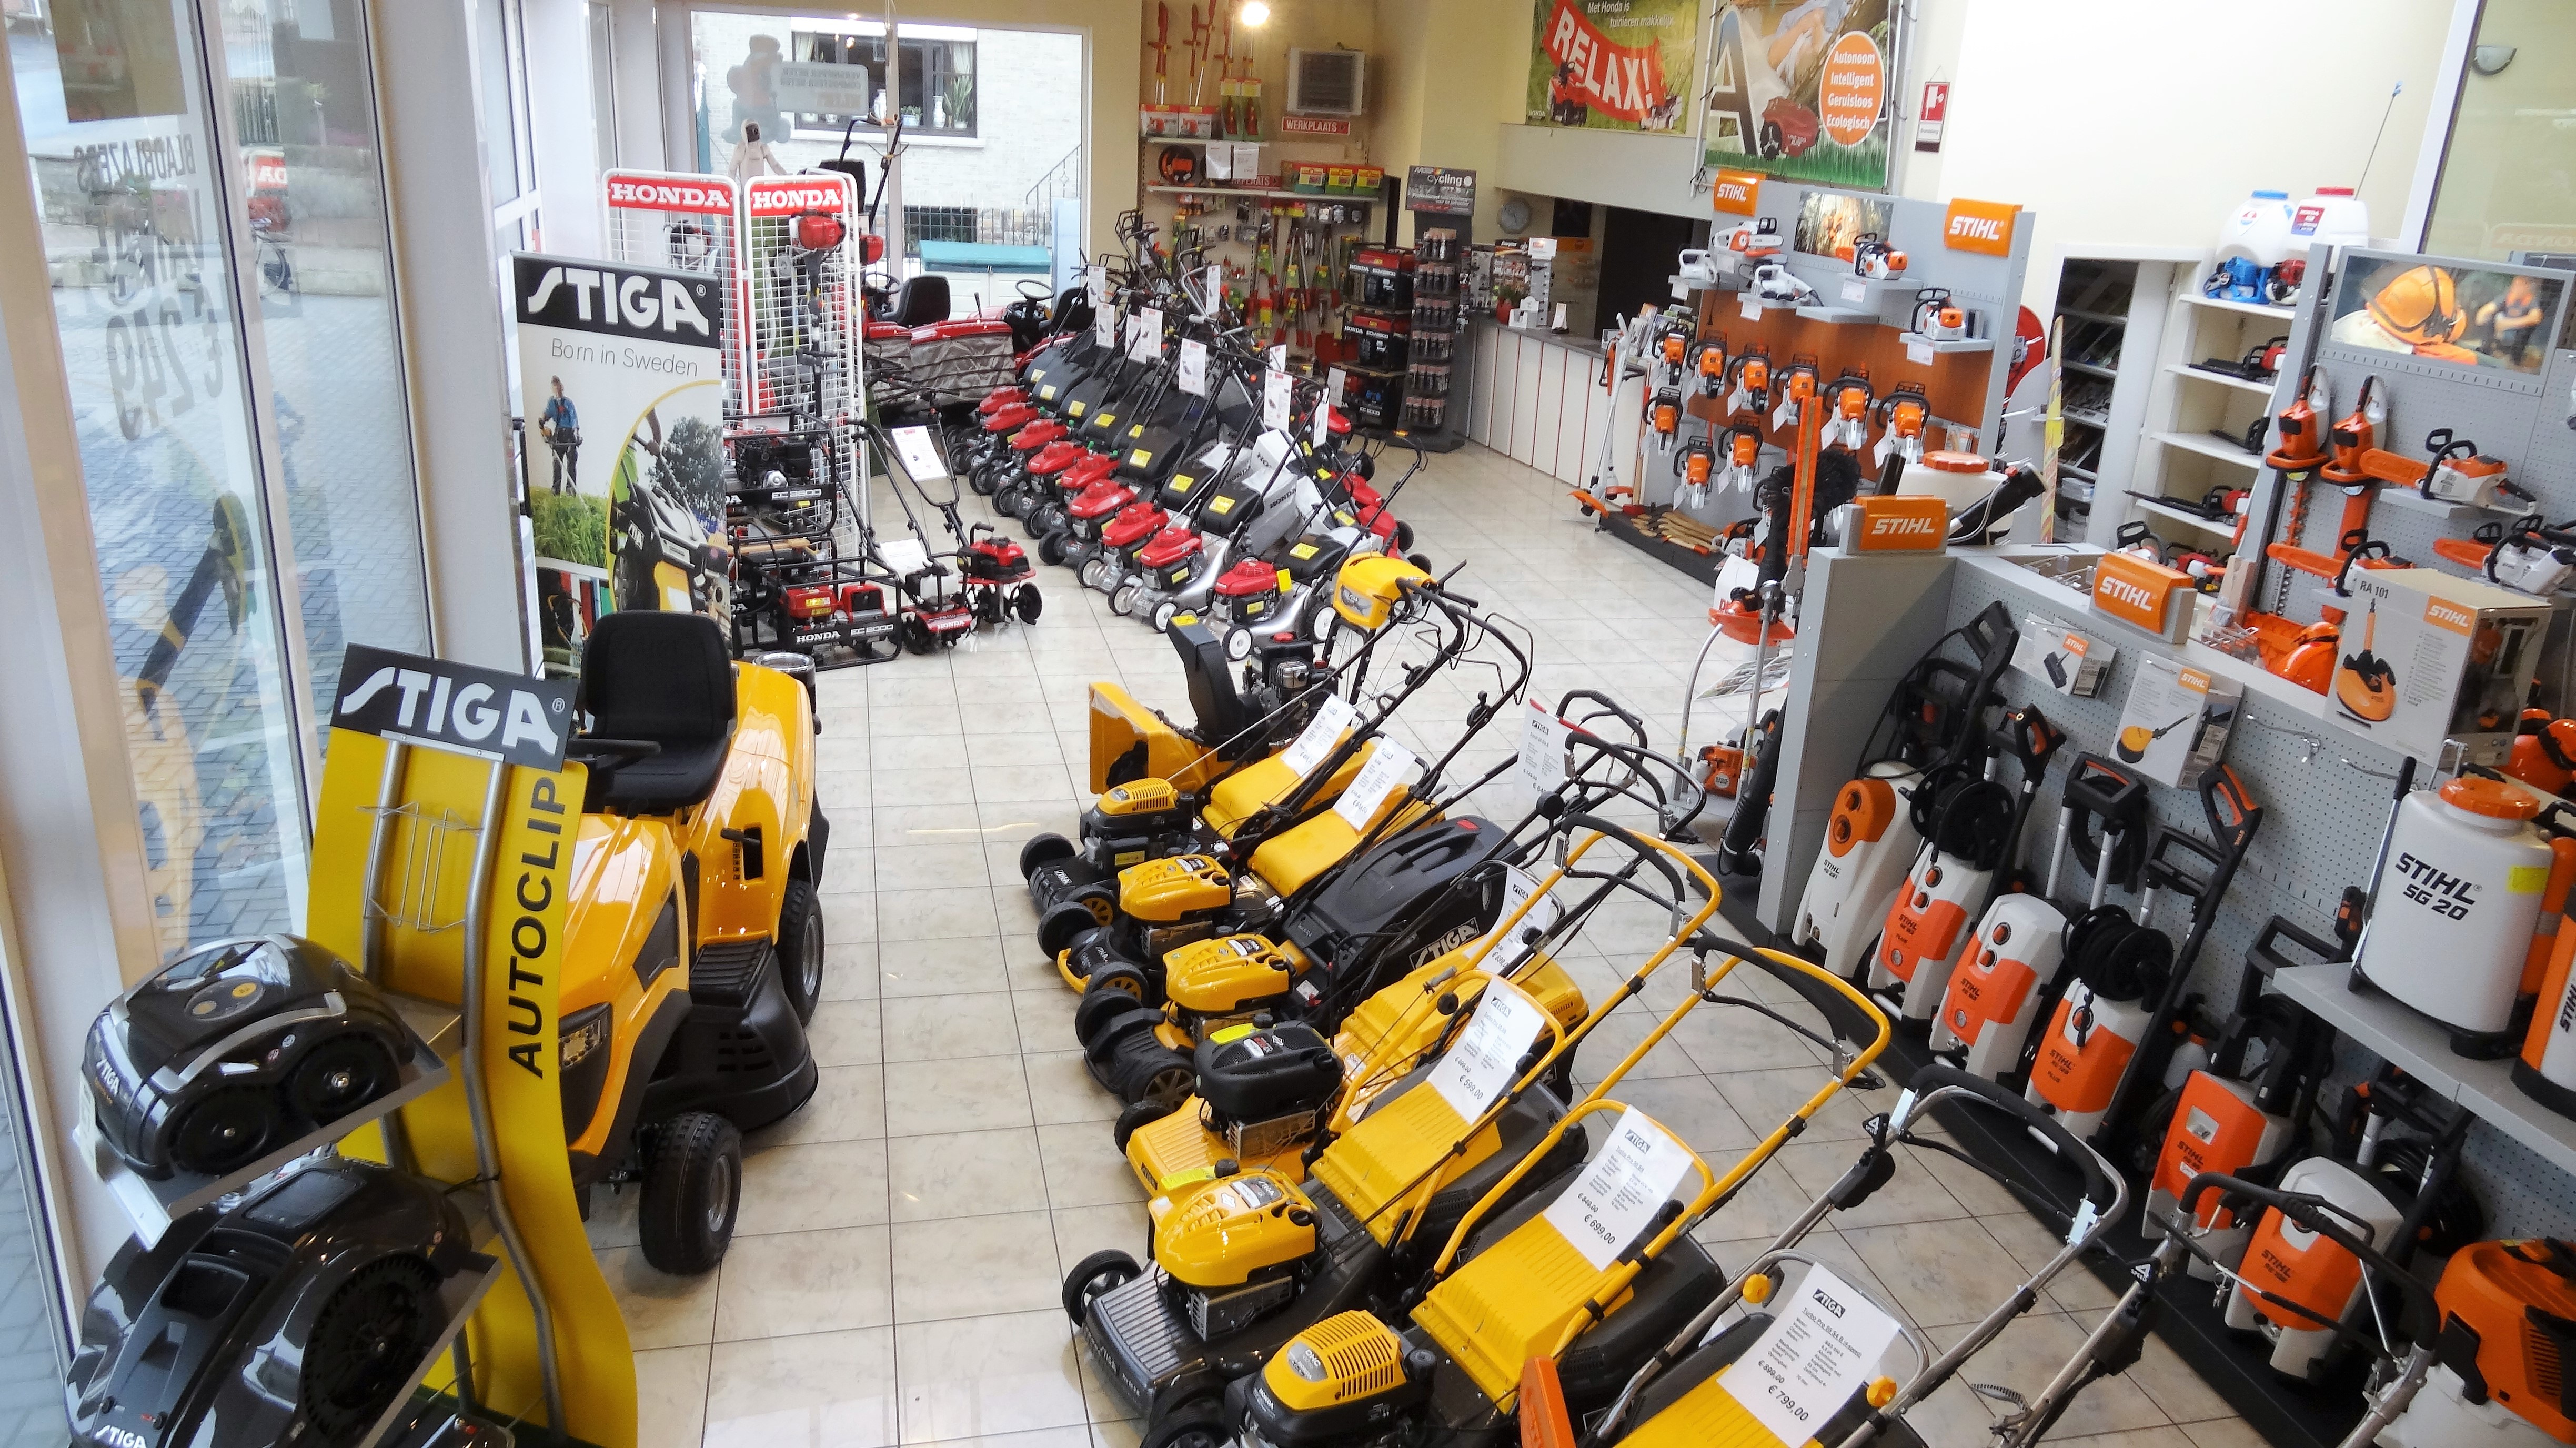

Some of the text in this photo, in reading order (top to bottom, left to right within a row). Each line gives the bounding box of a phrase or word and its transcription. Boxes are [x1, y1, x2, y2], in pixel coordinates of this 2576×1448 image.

[1604, 1, 1622, 12] Honda
[1553, 6, 1653, 110] RELAX!
[1833, 51, 1875, 64] Autonoom
[1831, 72, 1874, 89] Intelligent
[1828, 93, 1873, 107] Geruisloos
[1286, 119, 1337, 132] WERKPLAATS
[1827, 114, 1870, 131] Ecologisch
[611, 184, 729, 207] HONDA
[752, 189, 841, 208] HONDA
[1717, 183, 1747, 203] STIHL
[1949, 216, 2000, 240] STIHL
[528, 266, 710, 337] STIGA
[551, 338, 698, 377] Born in Sweden
[1871, 516, 1936, 535] STIHL
[2099, 576, 2153, 612] STIHL
[2360, 580, 2389, 599] RA 101
[938, 620, 965, 630] HONDA
[2428, 605, 2469, 627] STIHL
[797, 630, 841, 644] HONDA
[2065, 637, 2085, 652] STIHL
[2182, 672, 2208, 688] STIHL
[341, 666, 559, 755] STIGA
[1824, 859, 1840, 874] STIHL
[2395, 852, 2476, 906] STIHL
[2403, 883, 2469, 921] SG 20
[508, 778, 566, 1079] AUTOCLIP
[1899, 913, 1918, 931] STIHL
[1414, 921, 1477, 967] STIGA
[1960, 978, 1981, 996] STIHL
[2049, 1049, 2072, 1071] STIHL
[96, 1059, 120, 1097] STIGA
[1463, 1078, 1484, 1100] 599,00
[1624, 1130, 1651, 1154] STIGA
[2177, 1140, 2204, 1165] STIHL
[1584, 1214, 1615, 1244] € 699,00
[2261, 1248, 2291, 1279] STIHL
[1813, 1289, 1845, 1318] STIGA
[1802, 1307, 1817, 1322] Turbo
[1816, 1318, 1826, 1329] Pro
[1825, 1325, 1832, 1334] 55
[1305, 1349, 1321, 1367] OHC
[1763, 1364, 1785, 1384] 899,00
[1258, 1387, 1274, 1411] HONDA
[1768, 1385, 1809, 1421] € 799,00
[96, 1425, 147, 1447] STIGA
